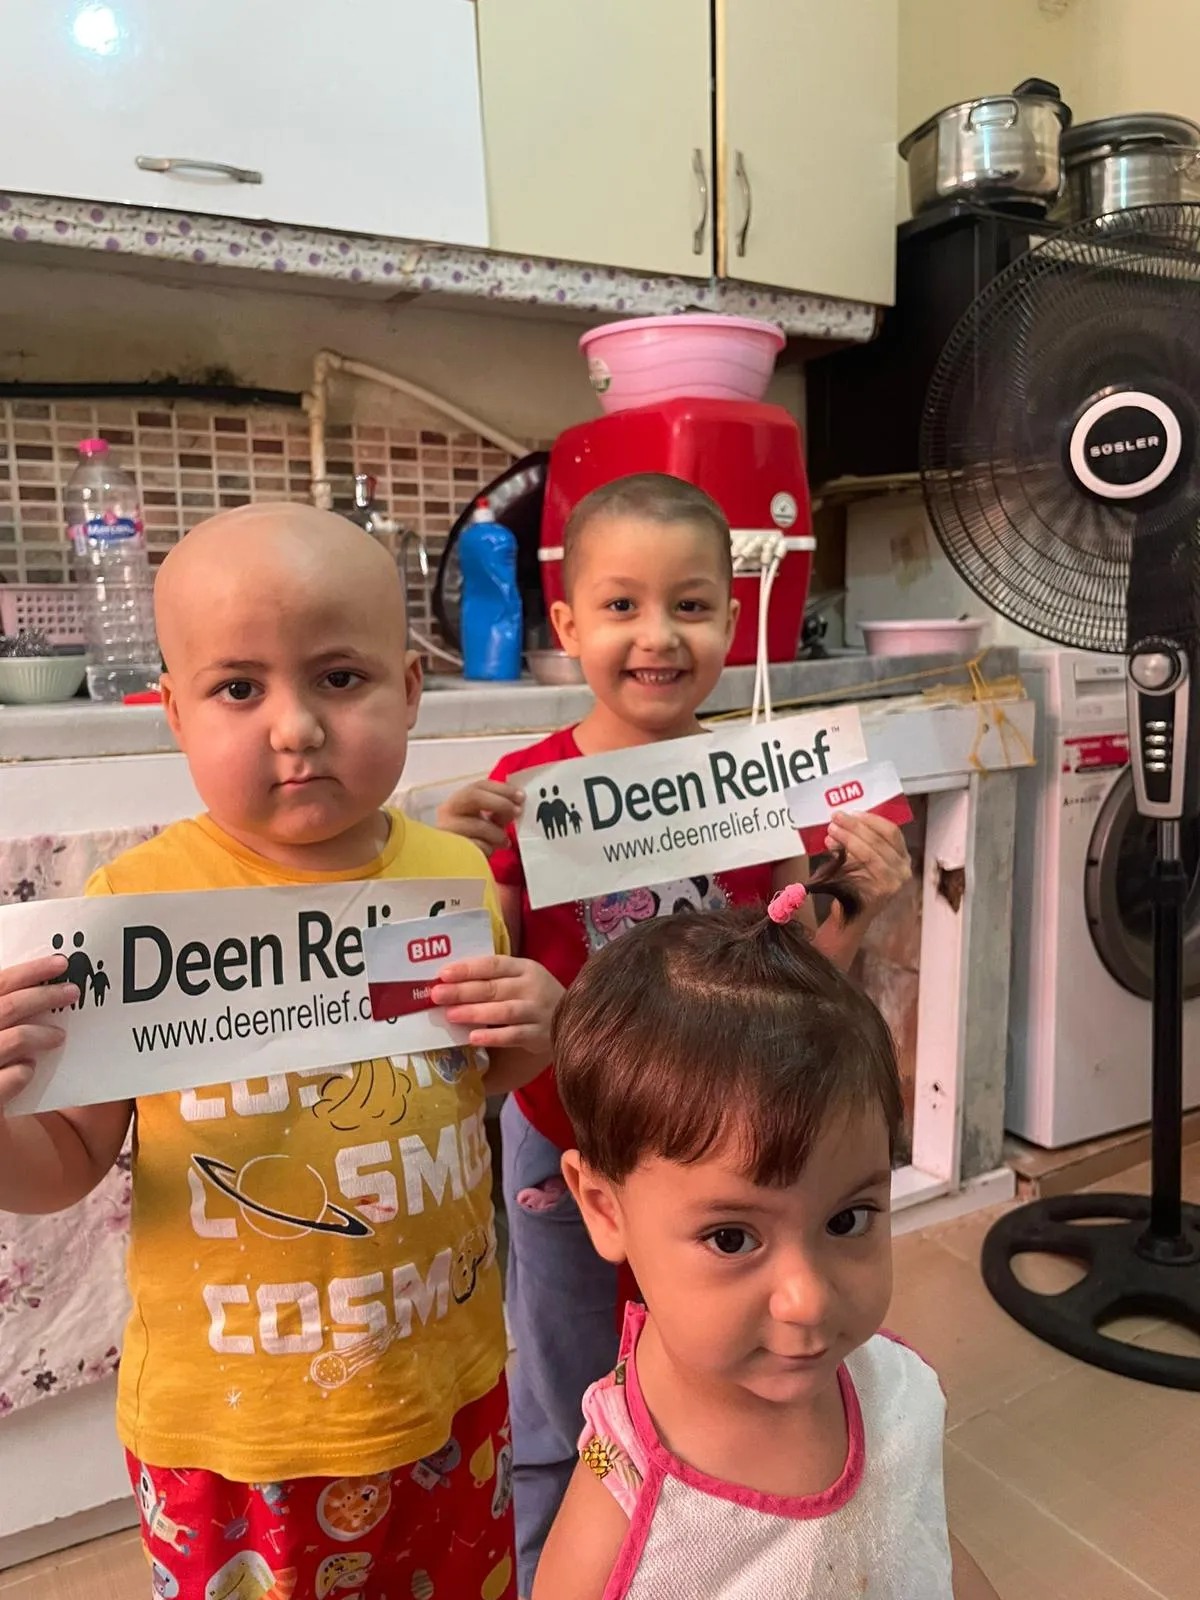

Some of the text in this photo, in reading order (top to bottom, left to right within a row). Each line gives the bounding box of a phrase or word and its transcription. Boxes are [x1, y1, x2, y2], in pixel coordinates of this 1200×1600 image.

[583, 770, 705, 831] Deen
[708, 729, 831, 805] Relief
[122, 924, 285, 1004] Deen
[132, 989, 398, 1053] www.deenrelief.o
